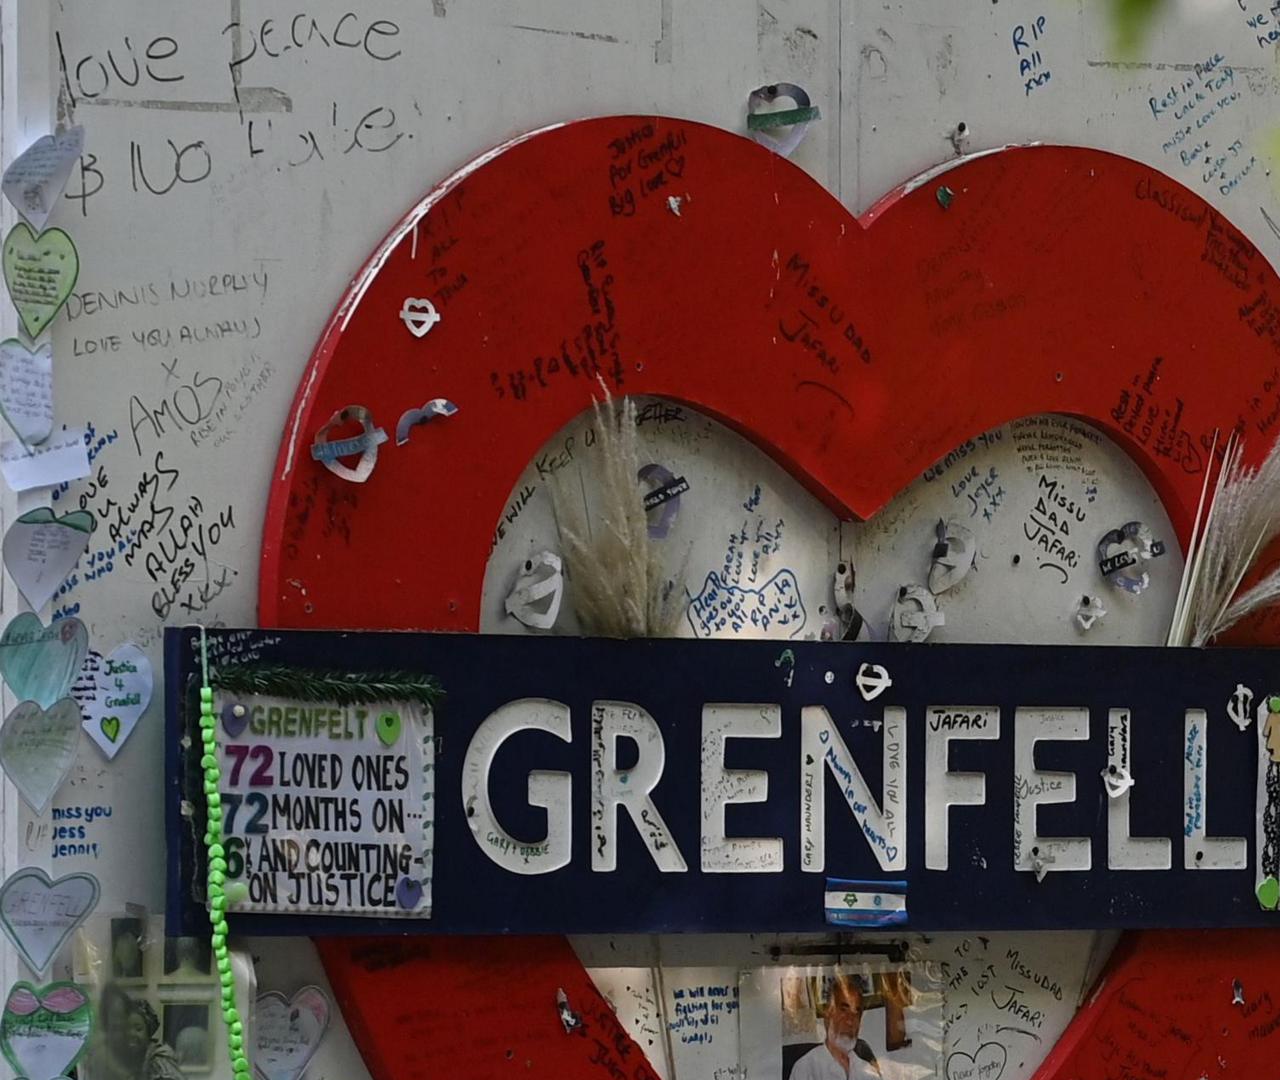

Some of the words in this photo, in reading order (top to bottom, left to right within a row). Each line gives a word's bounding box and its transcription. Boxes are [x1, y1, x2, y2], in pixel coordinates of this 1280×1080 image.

[1012, 15, 1047, 54] RIP
[56, 31, 184, 108] love
[221, 12, 401, 124] peace
[1020, 52, 1042, 76] All
[73, 335, 121, 357] LOVE
[129, 371, 223, 456] AMOS
[922, 463, 944, 483] WE
[945, 441, 977, 469] MISS
[978, 430, 1004, 450] YOU
[951, 465, 980, 498] LOVE
[1034, 496, 1070, 536] DAD
[152, 558, 196, 621] BLESS
[250, 705, 368, 740] GRENFELT
[225, 745, 274, 787] 72
[278, 751, 343, 791] LOVED
[352, 755, 409, 791] ONES
[462, 698, 1247, 874] GRENFELL
[1018, 779, 1063, 799] Justice
[85, 805, 112, 822] you
[221, 792, 270, 834] 72
[272, 793, 362, 833] MONTHS
[223, 837, 245, 879] 6
[258, 836, 300, 874] AND
[803, 839, 815, 866] GARY
[249, 872, 277, 904] ON
[287, 872, 396, 907] JUSTICE
